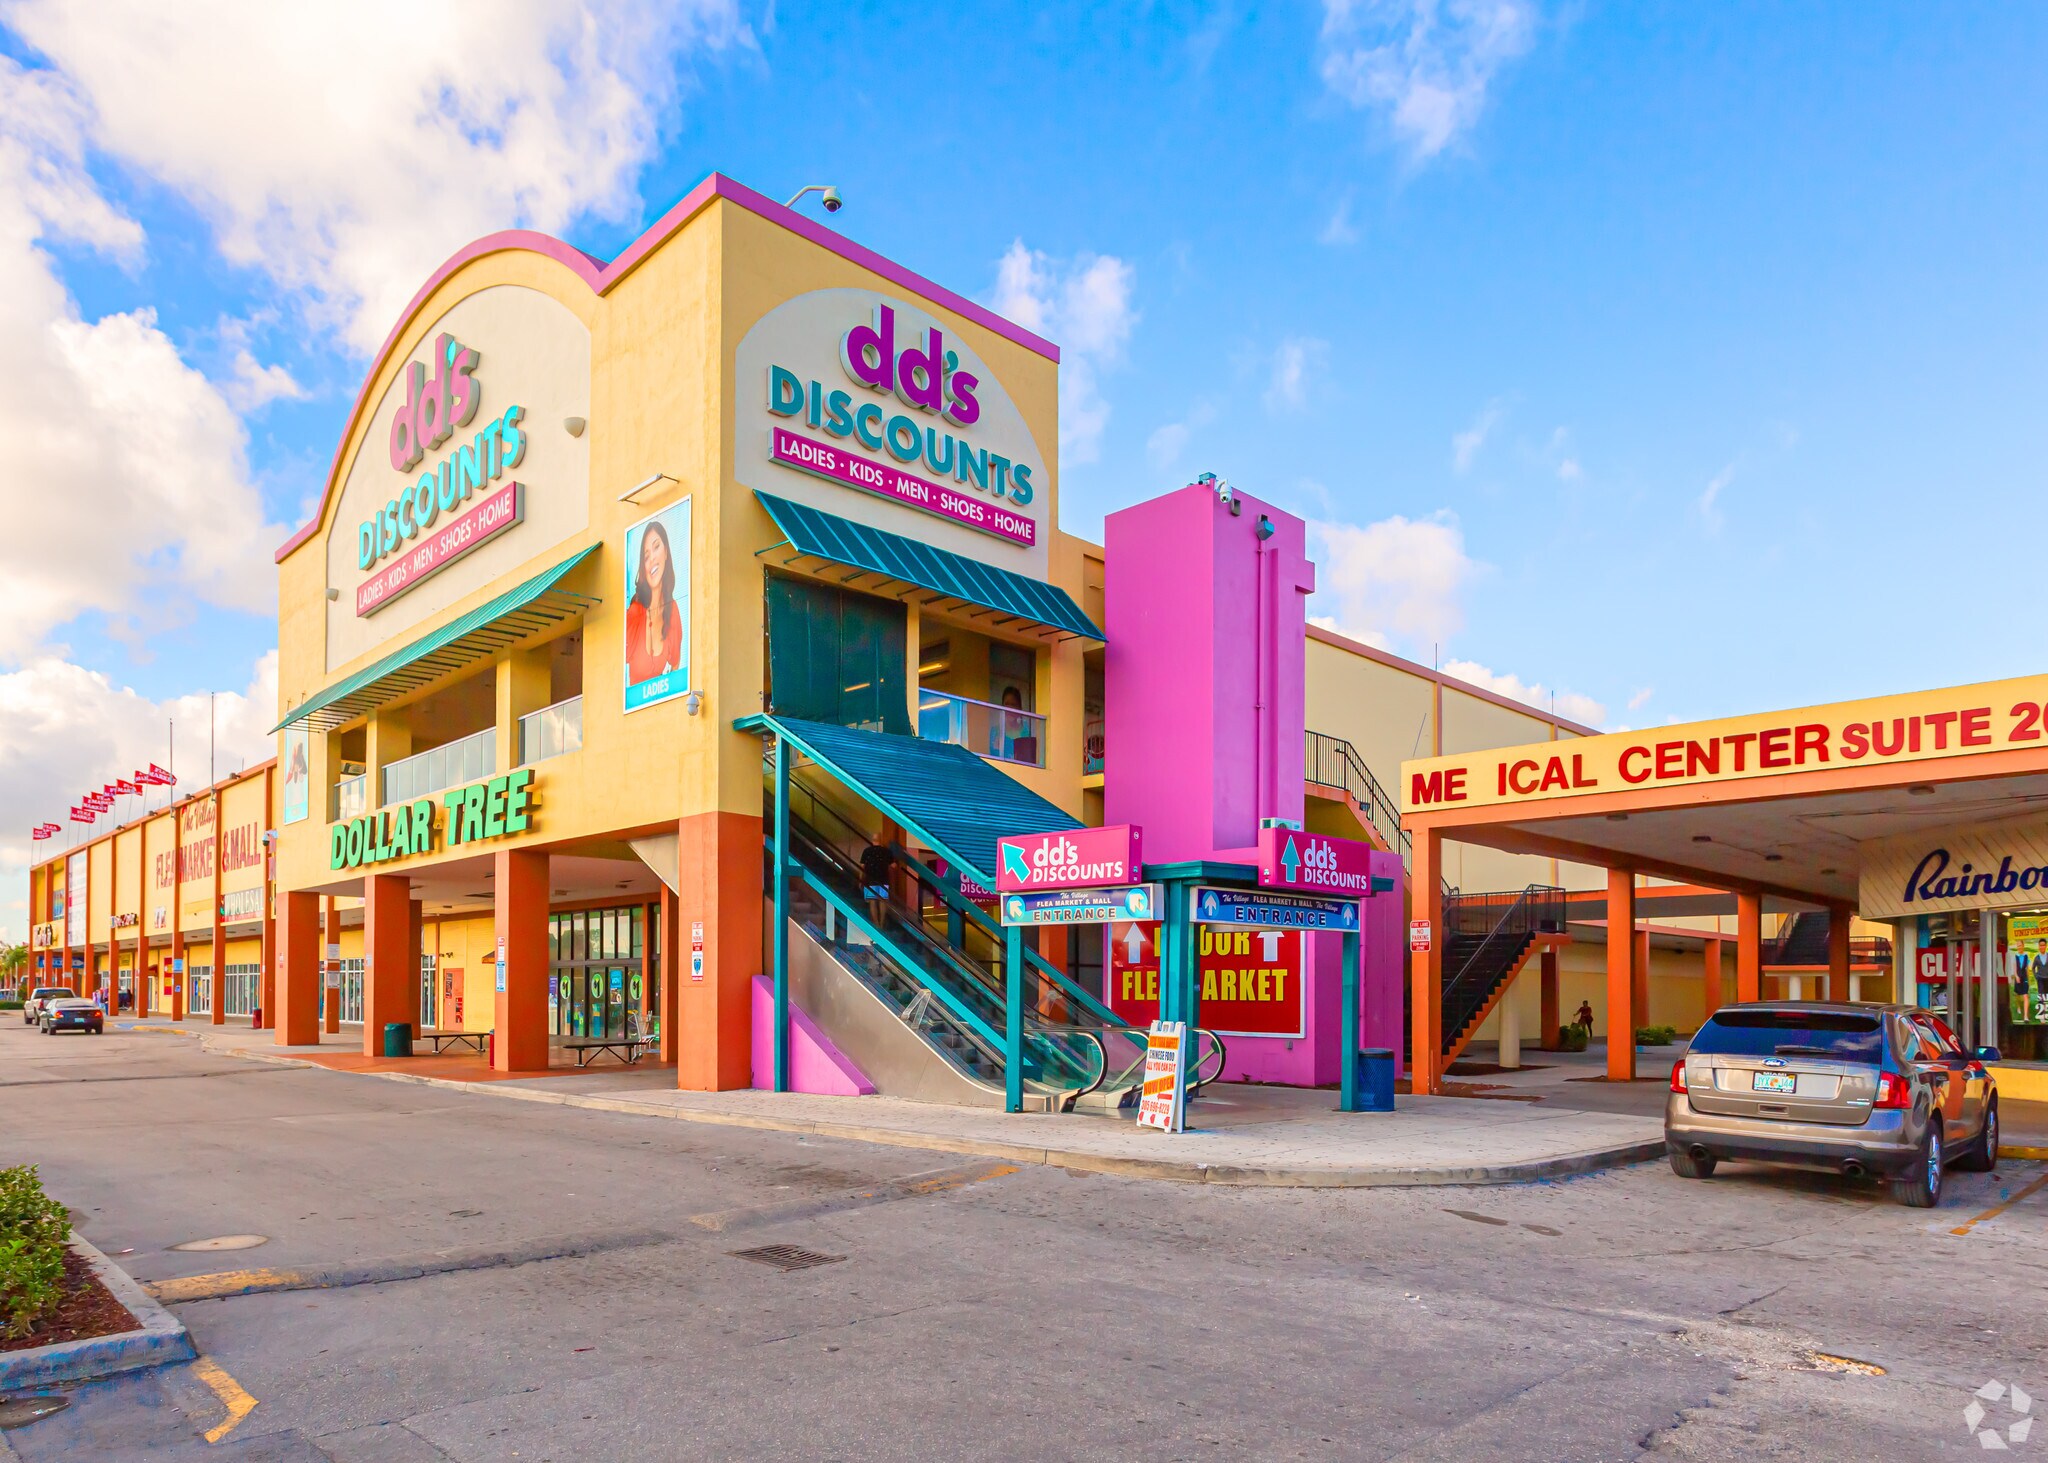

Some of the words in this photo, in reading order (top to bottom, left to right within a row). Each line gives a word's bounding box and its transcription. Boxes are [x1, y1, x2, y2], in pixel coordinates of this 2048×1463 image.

[839, 303, 980, 428] dd's
[390, 332, 480, 473] dd's
[767, 364, 1033, 506] DISCOUNTS
[359, 405, 527, 571] DISCOUNTS
[780, 436, 836, 469] LADIES
[849, 460, 884, 487] KIDS
[896, 477, 929, 503] MEN
[940, 493, 984, 522] SHOES
[994, 512, 1032, 540] HOME
[358, 575, 384, 609] LADIES
[387, 562, 407, 590] KIDS
[412, 544, 433, 574] MEN
[440, 518, 471, 555] SHOES
[478, 492, 511, 532] HOME
[643, 678, 669, 699] LADIES
[1411, 767, 1467, 805] ME
[1498, 753, 1598, 796] ICAL
[1618, 723, 1830, 784] CENTER
[1840, 706, 1992, 760] SUITE
[2008, 701, 2048, 742] 2
[330, 799, 435, 870] DOLLAR
[444, 769, 536, 845] TREE
[231, 822, 260, 870] MALL
[1033, 836, 1079, 867] dd's
[1304, 838, 1338, 871] dd's
[1032, 861, 1123, 883] DISCOUNTS
[1304, 867, 1367, 890] DISCOUNTS
[1904, 848, 2048, 903] Rainbo
[223, 887, 264, 916] WHOLESAL
[1071, 892, 1088, 900] Village
[1222, 894, 1232, 903] The
[1232, 894, 1249, 904] Village
[1253, 895, 1268, 904] FLEA
[1269, 896, 1292, 906] MARKET
[1298, 899, 1313, 908] MALL
[1033, 907, 1116, 921] ENTRANCE
[1235, 906, 1327, 927] ENTRANCE
[1122, 970, 1160, 1001] FLE
[1202, 968, 1288, 1002] ARKET
[1149, 1049, 1164, 1060] CHINESE
[1164, 1051, 1175, 1062] FOOD
[1160, 1063, 1169, 1072] CAN
[1143, 1080, 1158, 1096] NOW
[1159, 1075, 1174, 1093] OPEN
